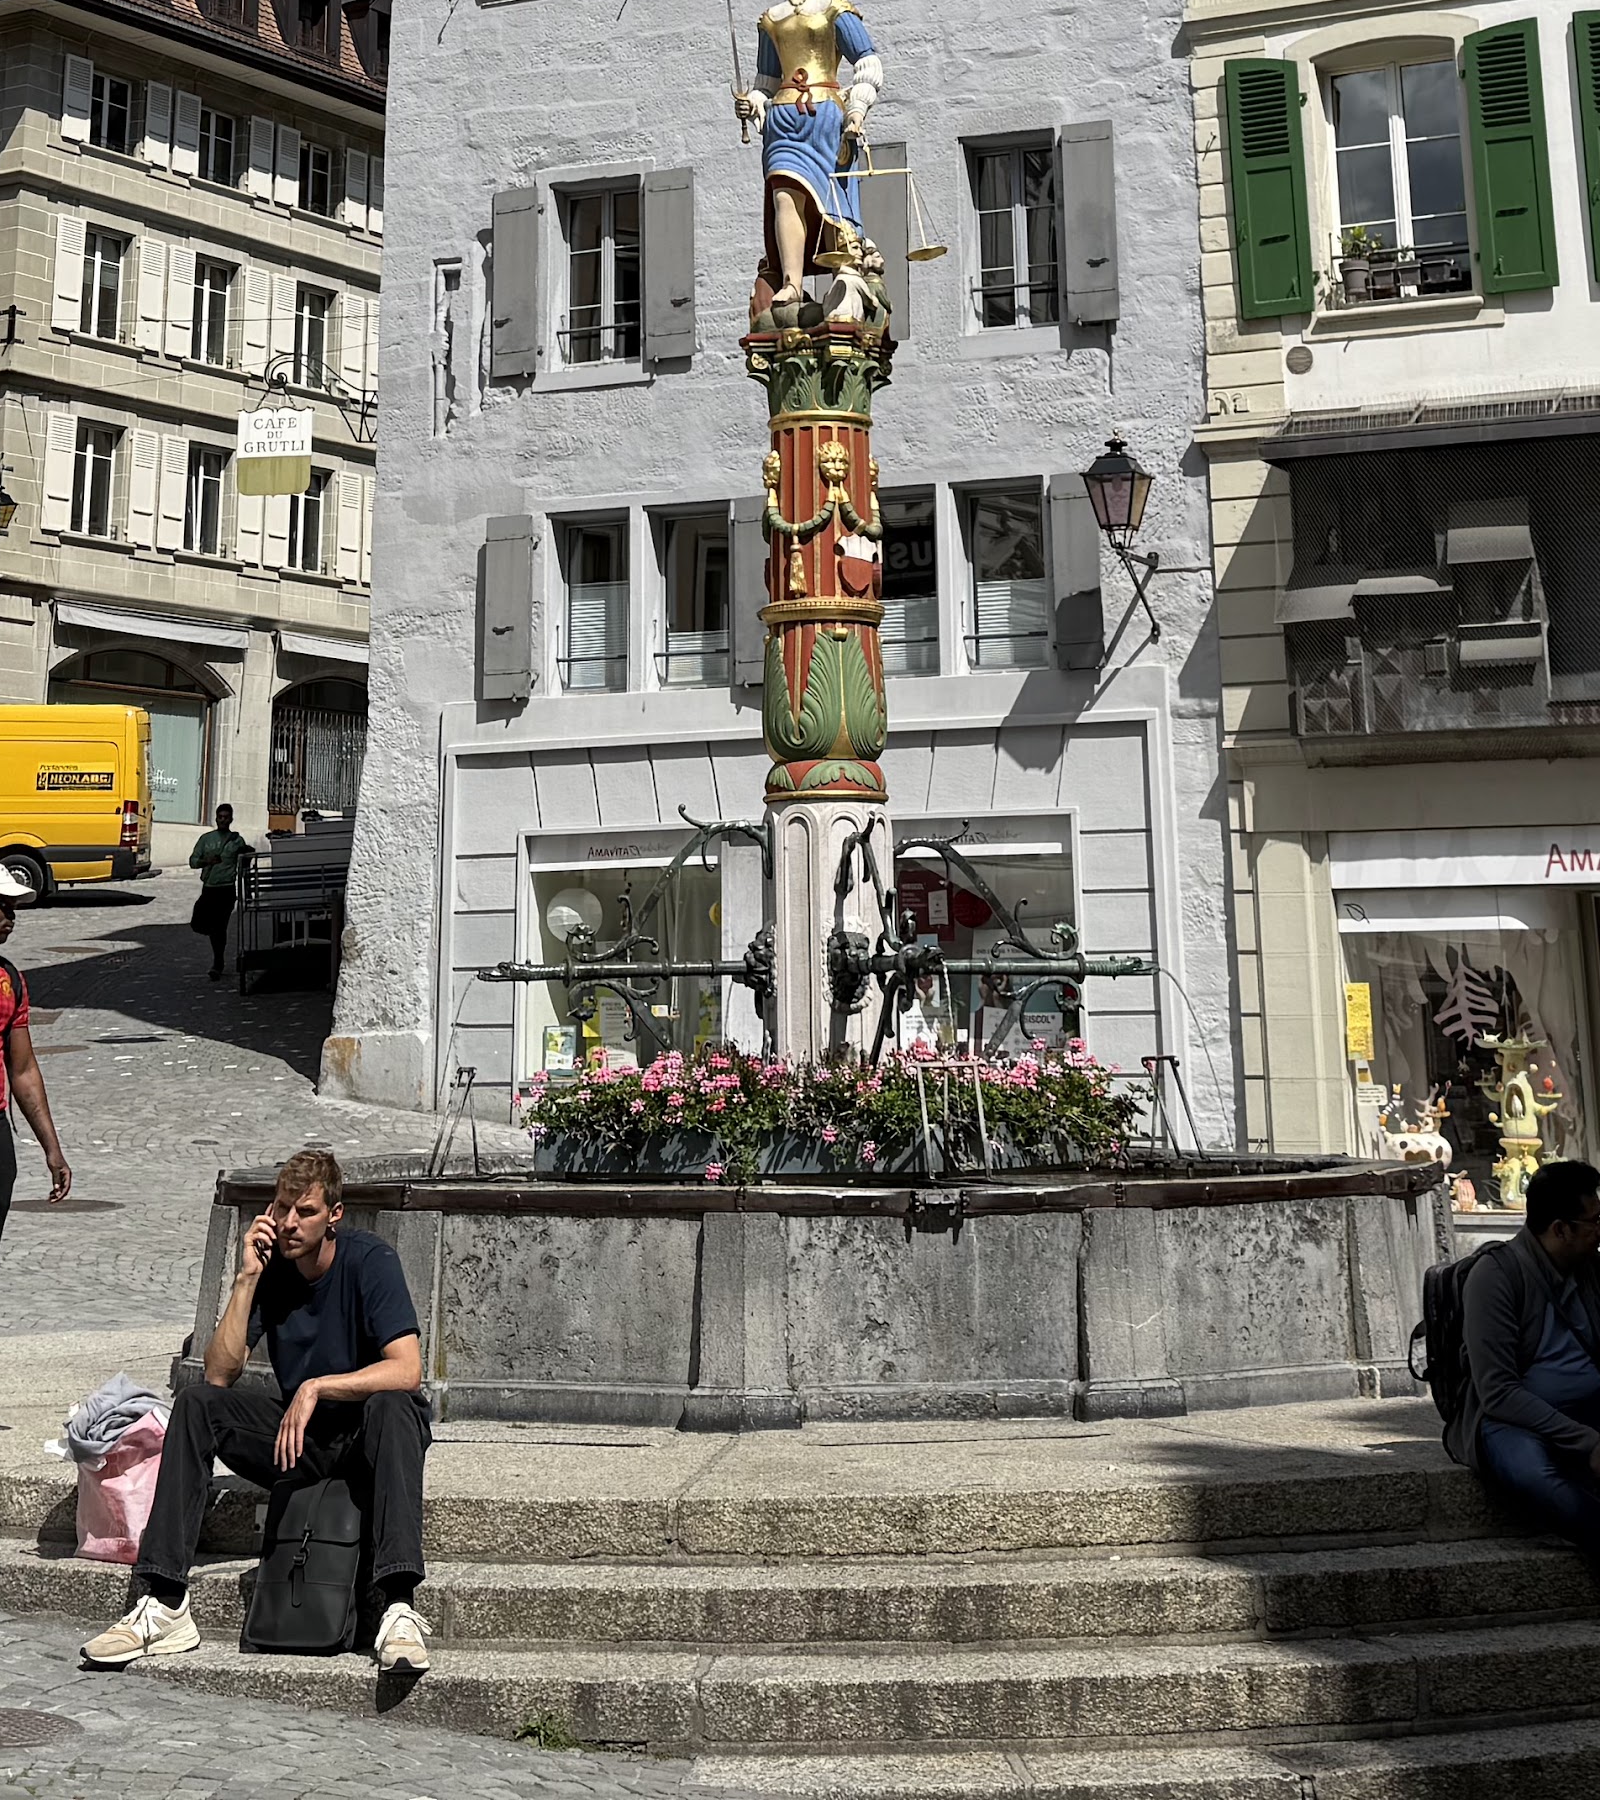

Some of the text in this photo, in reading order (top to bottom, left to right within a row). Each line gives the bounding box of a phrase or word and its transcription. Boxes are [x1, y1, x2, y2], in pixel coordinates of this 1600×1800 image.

[267, 430, 283, 439] DU
[244, 440, 305, 453] GRUTLI
[587, 846, 629, 860] AMAVITA
